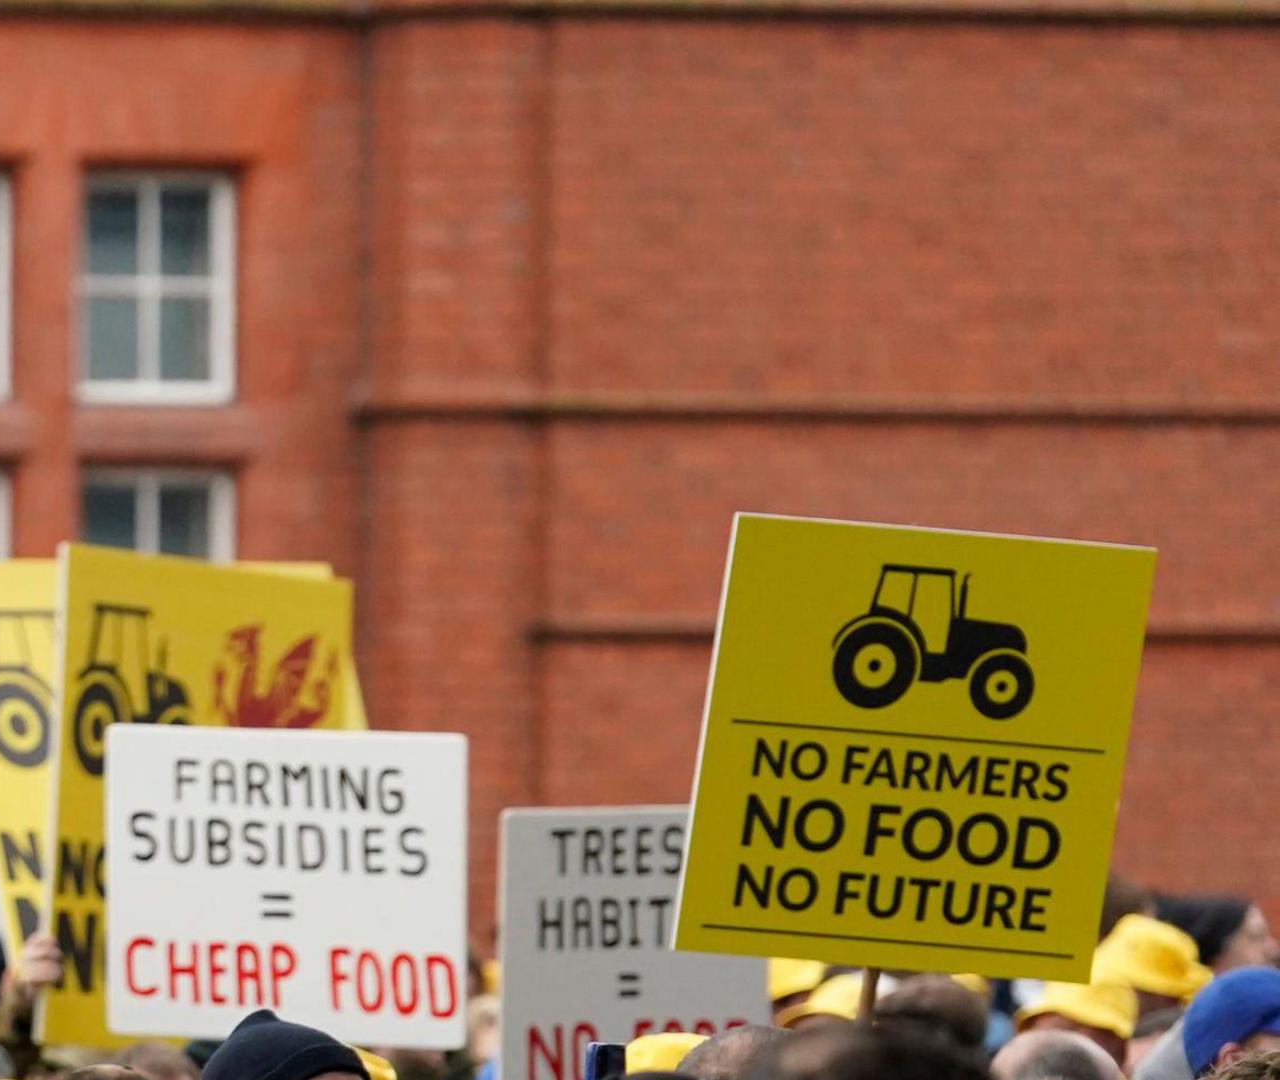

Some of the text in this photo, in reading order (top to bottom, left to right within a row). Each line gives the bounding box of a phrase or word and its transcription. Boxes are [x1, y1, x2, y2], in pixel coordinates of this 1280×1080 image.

[175, 759, 406, 816] FARMING
[751, 737, 1070, 804] NO FARMERS
[129, 811, 428, 878] SUBSIDIES
[549, 823, 685, 878] TREES
[741, 793, 1061, 871] NO FOOD
[733, 863, 1052, 933] NO FUTURE
[124, 936, 459, 1021] CHEAP FOOD
